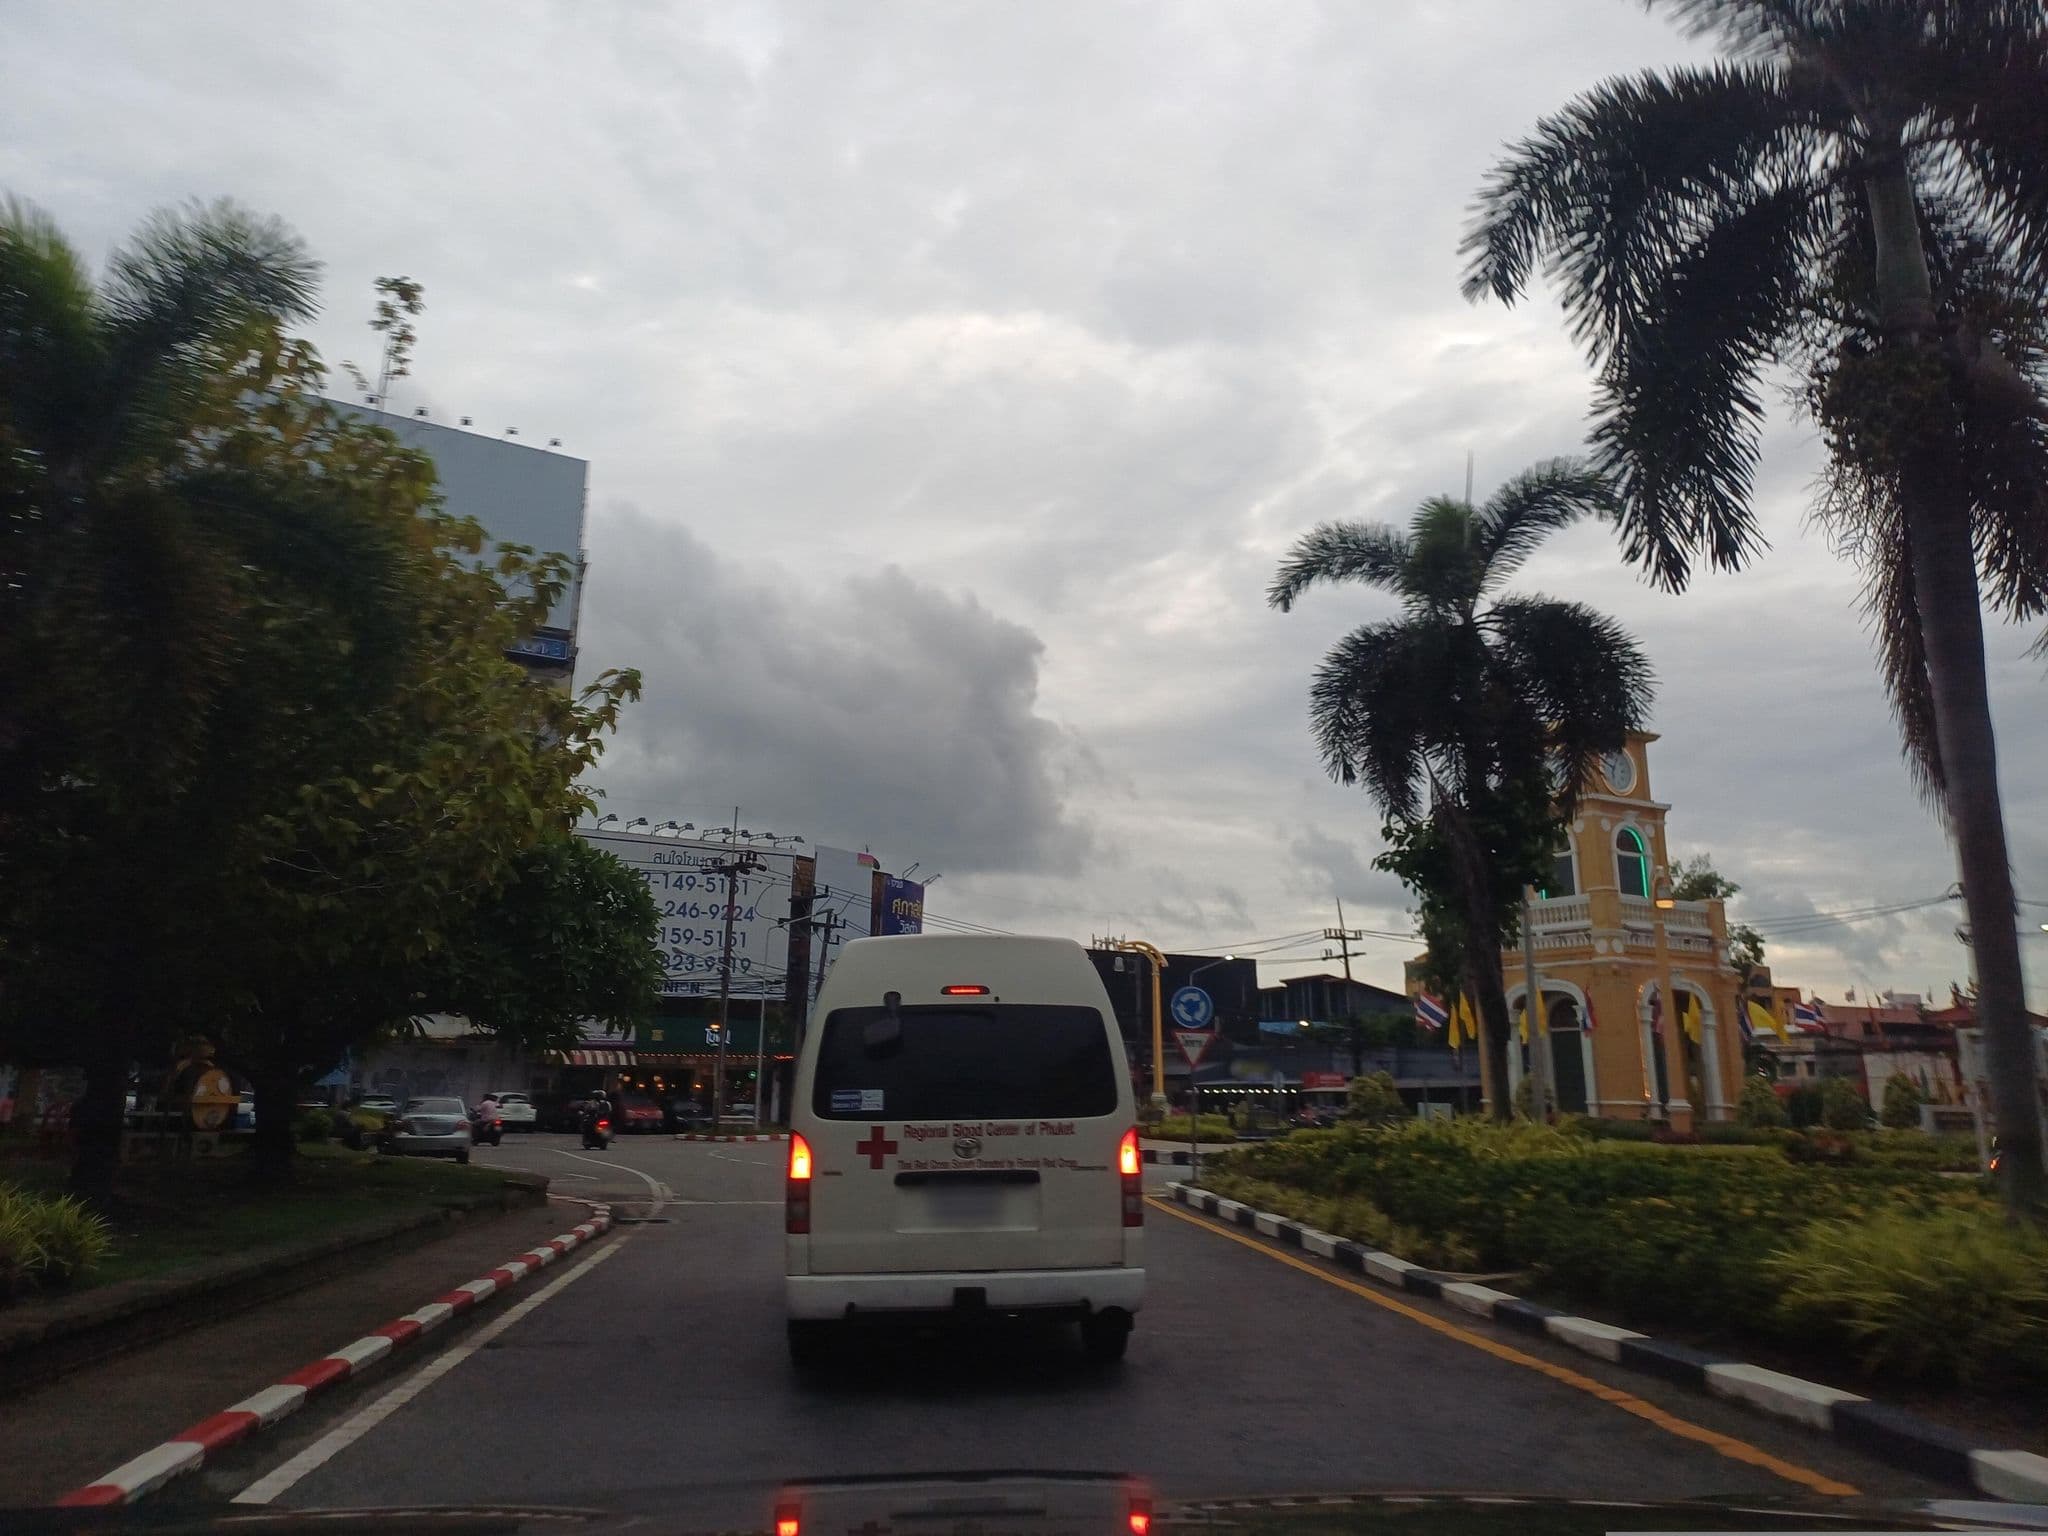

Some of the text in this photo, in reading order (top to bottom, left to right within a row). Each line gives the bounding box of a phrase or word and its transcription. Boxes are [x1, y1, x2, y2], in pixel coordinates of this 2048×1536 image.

[904, 1124, 947, 1141] Regional
[952, 1122, 984, 1136] Blood
[1039, 1121, 1075, 1136] Phuket
